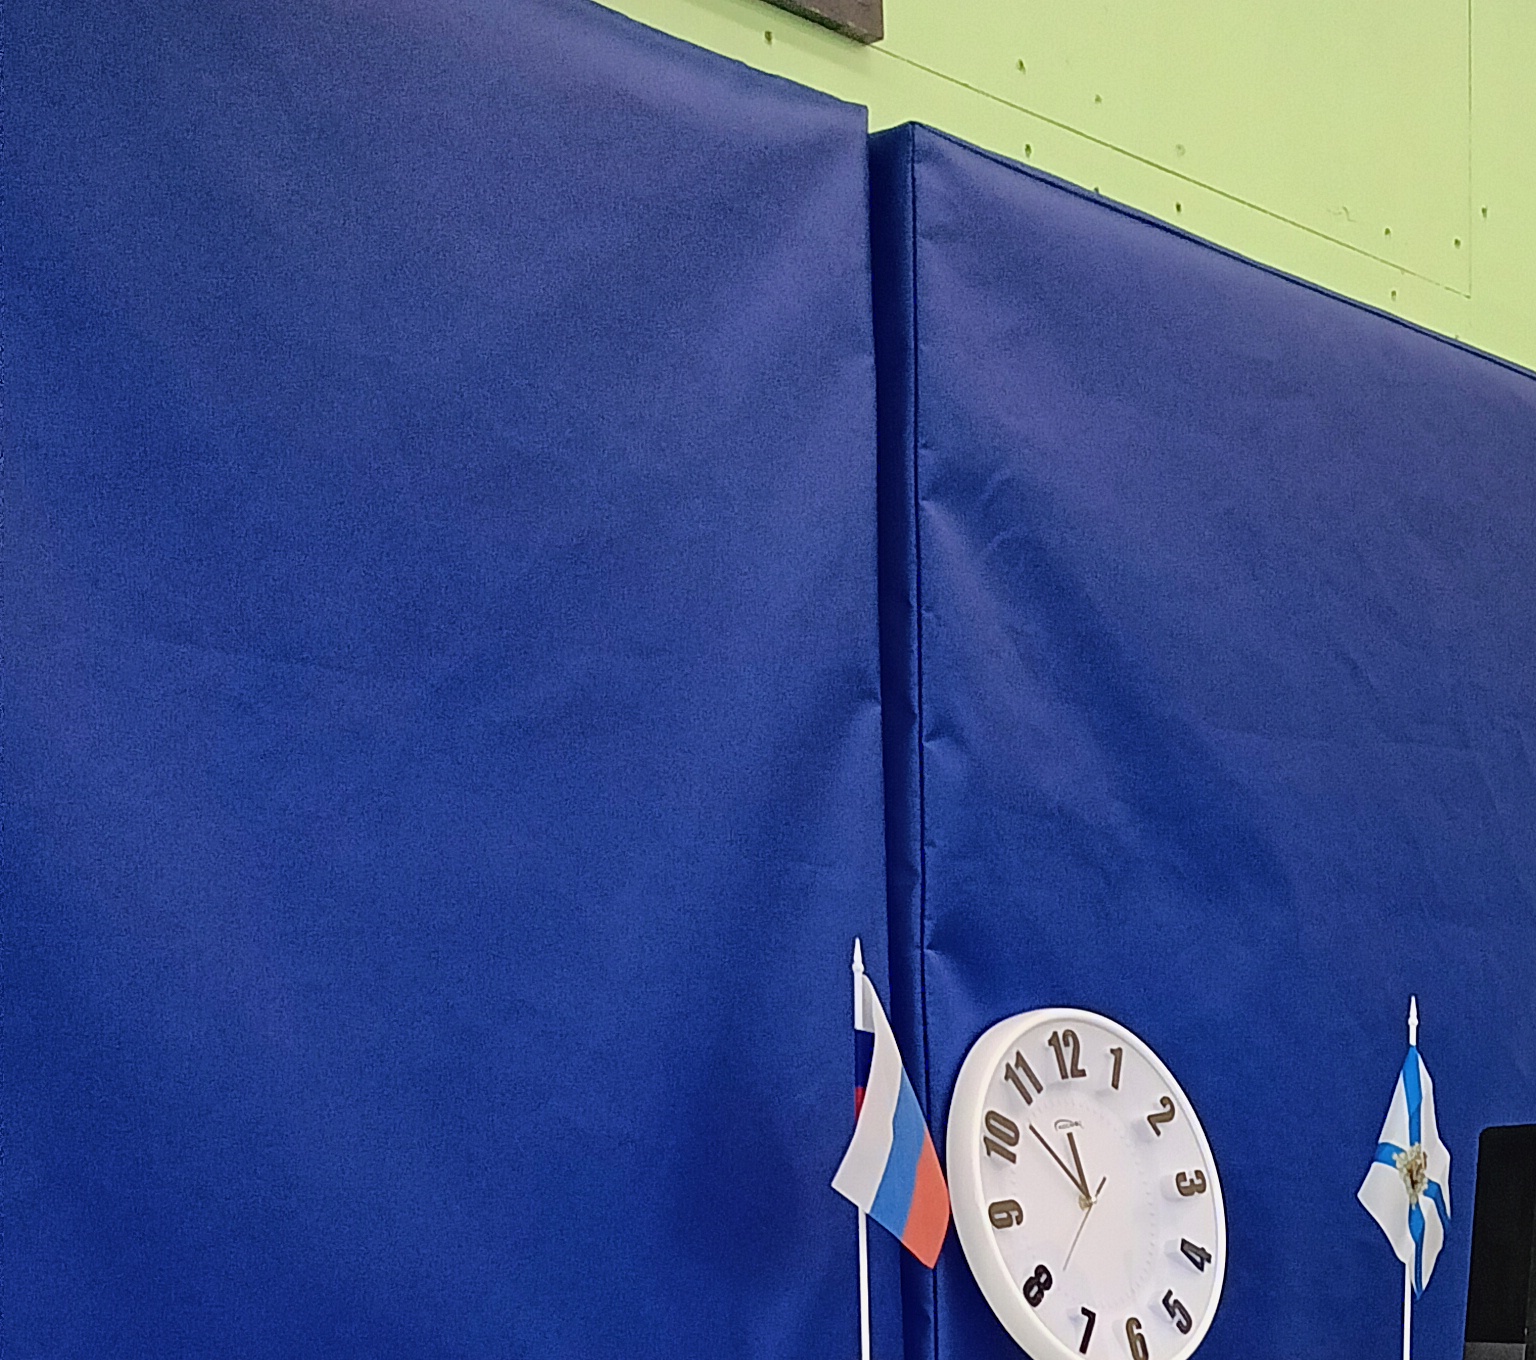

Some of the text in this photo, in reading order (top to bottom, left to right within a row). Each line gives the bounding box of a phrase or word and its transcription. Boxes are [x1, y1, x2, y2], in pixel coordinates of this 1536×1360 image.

[1048, 1029, 1086, 1079] 12
[1110, 1047, 1123, 1090] 1
[1005, 1051, 1043, 1104] 11
[984, 1110, 1020, 1164] 10
[1147, 1096, 1175, 1136] 2
[1176, 1170, 1206, 1196] 3
[989, 1199, 1023, 1229] 9
[1181, 1239, 1211, 1272] 4
[1023, 1265, 1052, 1307] 8
[1080, 1307, 1095, 1354] 7
[1163, 1290, 1192, 1334] 5
